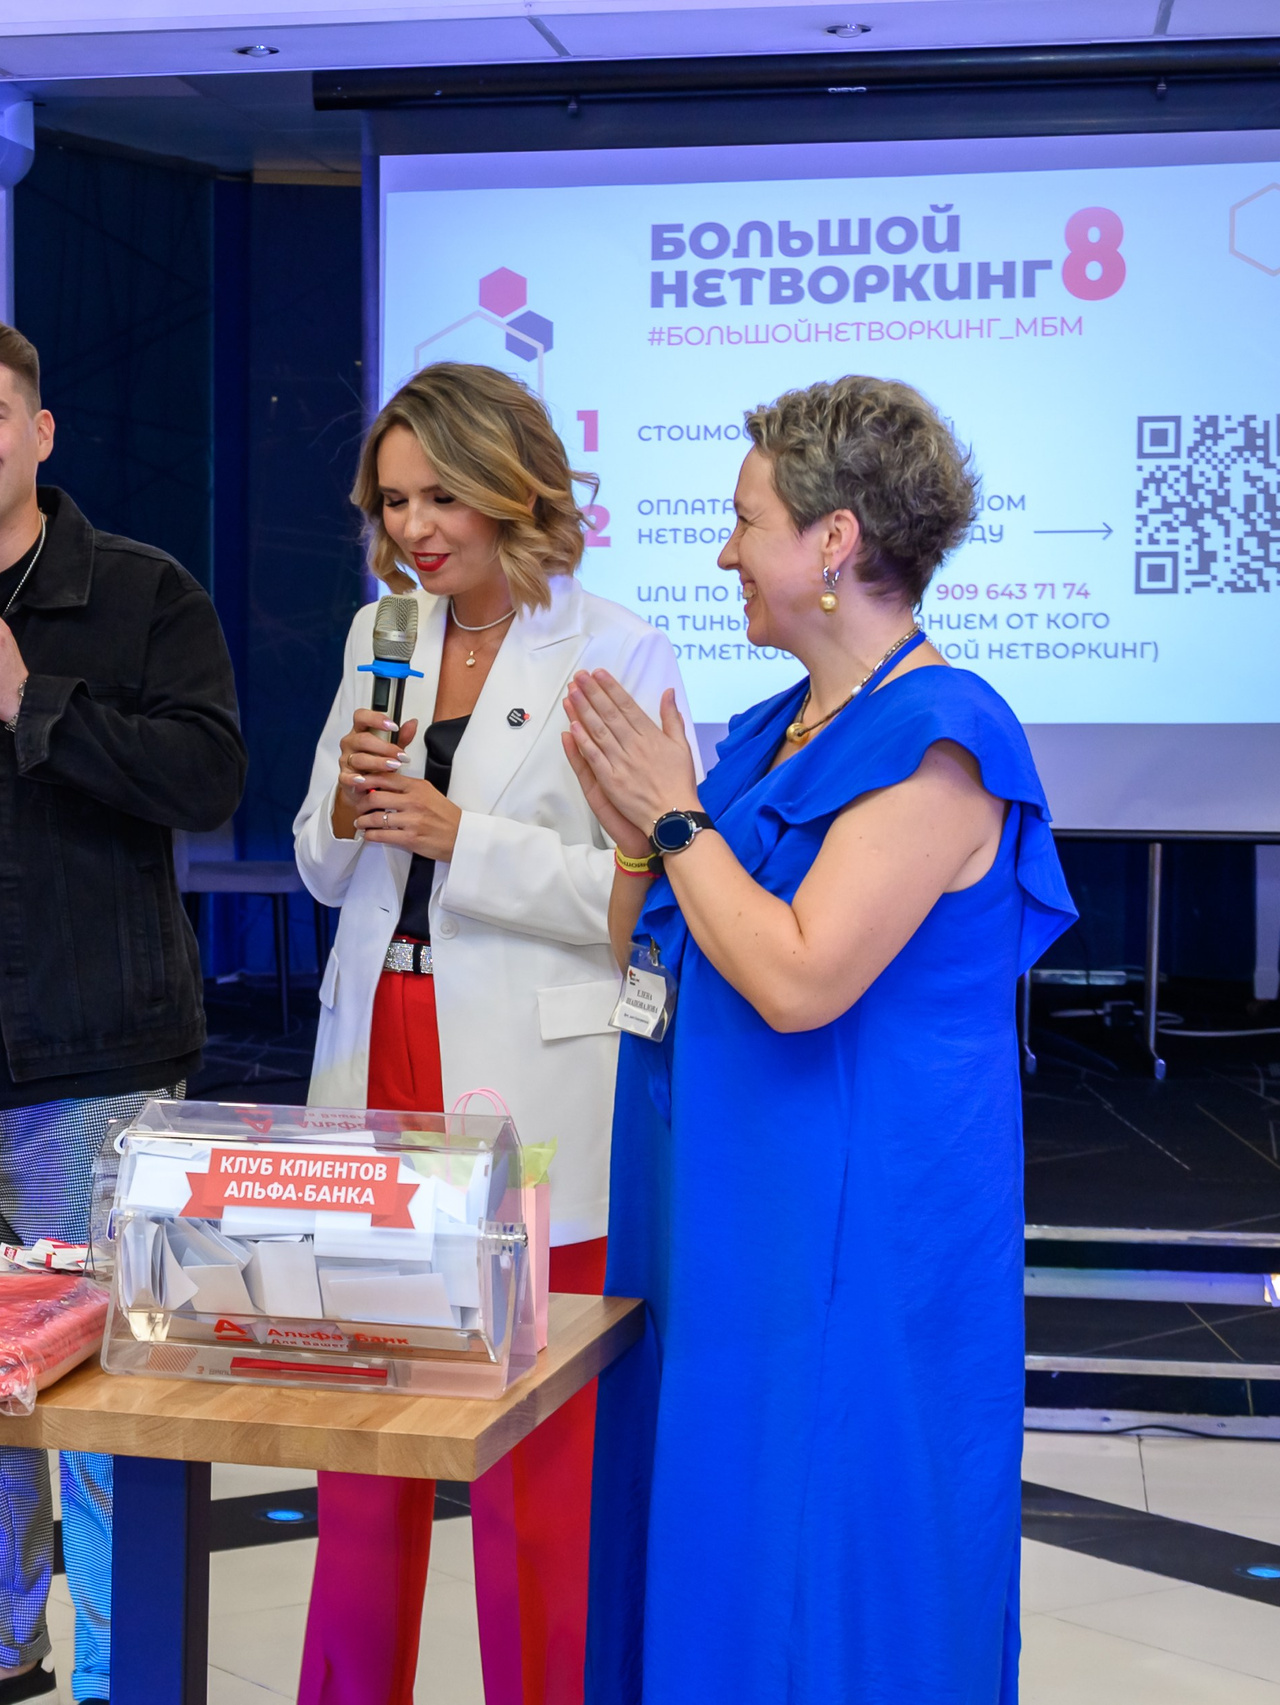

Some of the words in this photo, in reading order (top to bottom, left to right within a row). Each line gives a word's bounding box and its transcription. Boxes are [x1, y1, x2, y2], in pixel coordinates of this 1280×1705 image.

[650, 203, 961, 261] БОЛЬШОЙ
[1061, 206, 1127, 301] 8
[650, 259, 1053, 308] НЕТВОРКИНГ
[647, 315, 1084, 347] #БОЛЬШОЙНЕТВОРКИНГ_МБМ
[576, 409, 599, 452] 1
[583, 503, 611, 547] 2
[637, 585, 686, 602] ИЛИ
[694, 585, 729, 602] ПО
[935, 583, 979, 601] 909
[986, 583, 1028, 600] 643
[1034, 582, 1056, 600] 71
[1063, 582, 1091, 600] 74
[1006, 612, 1039, 630] ОТ
[1046, 612, 1111, 630] КОГО
[987, 641, 1159, 663] НЕТВОРКИНГ)
[219, 1155, 273, 1176] КЛУБ
[279, 1158, 388, 1182] КЛИЕНТОВ
